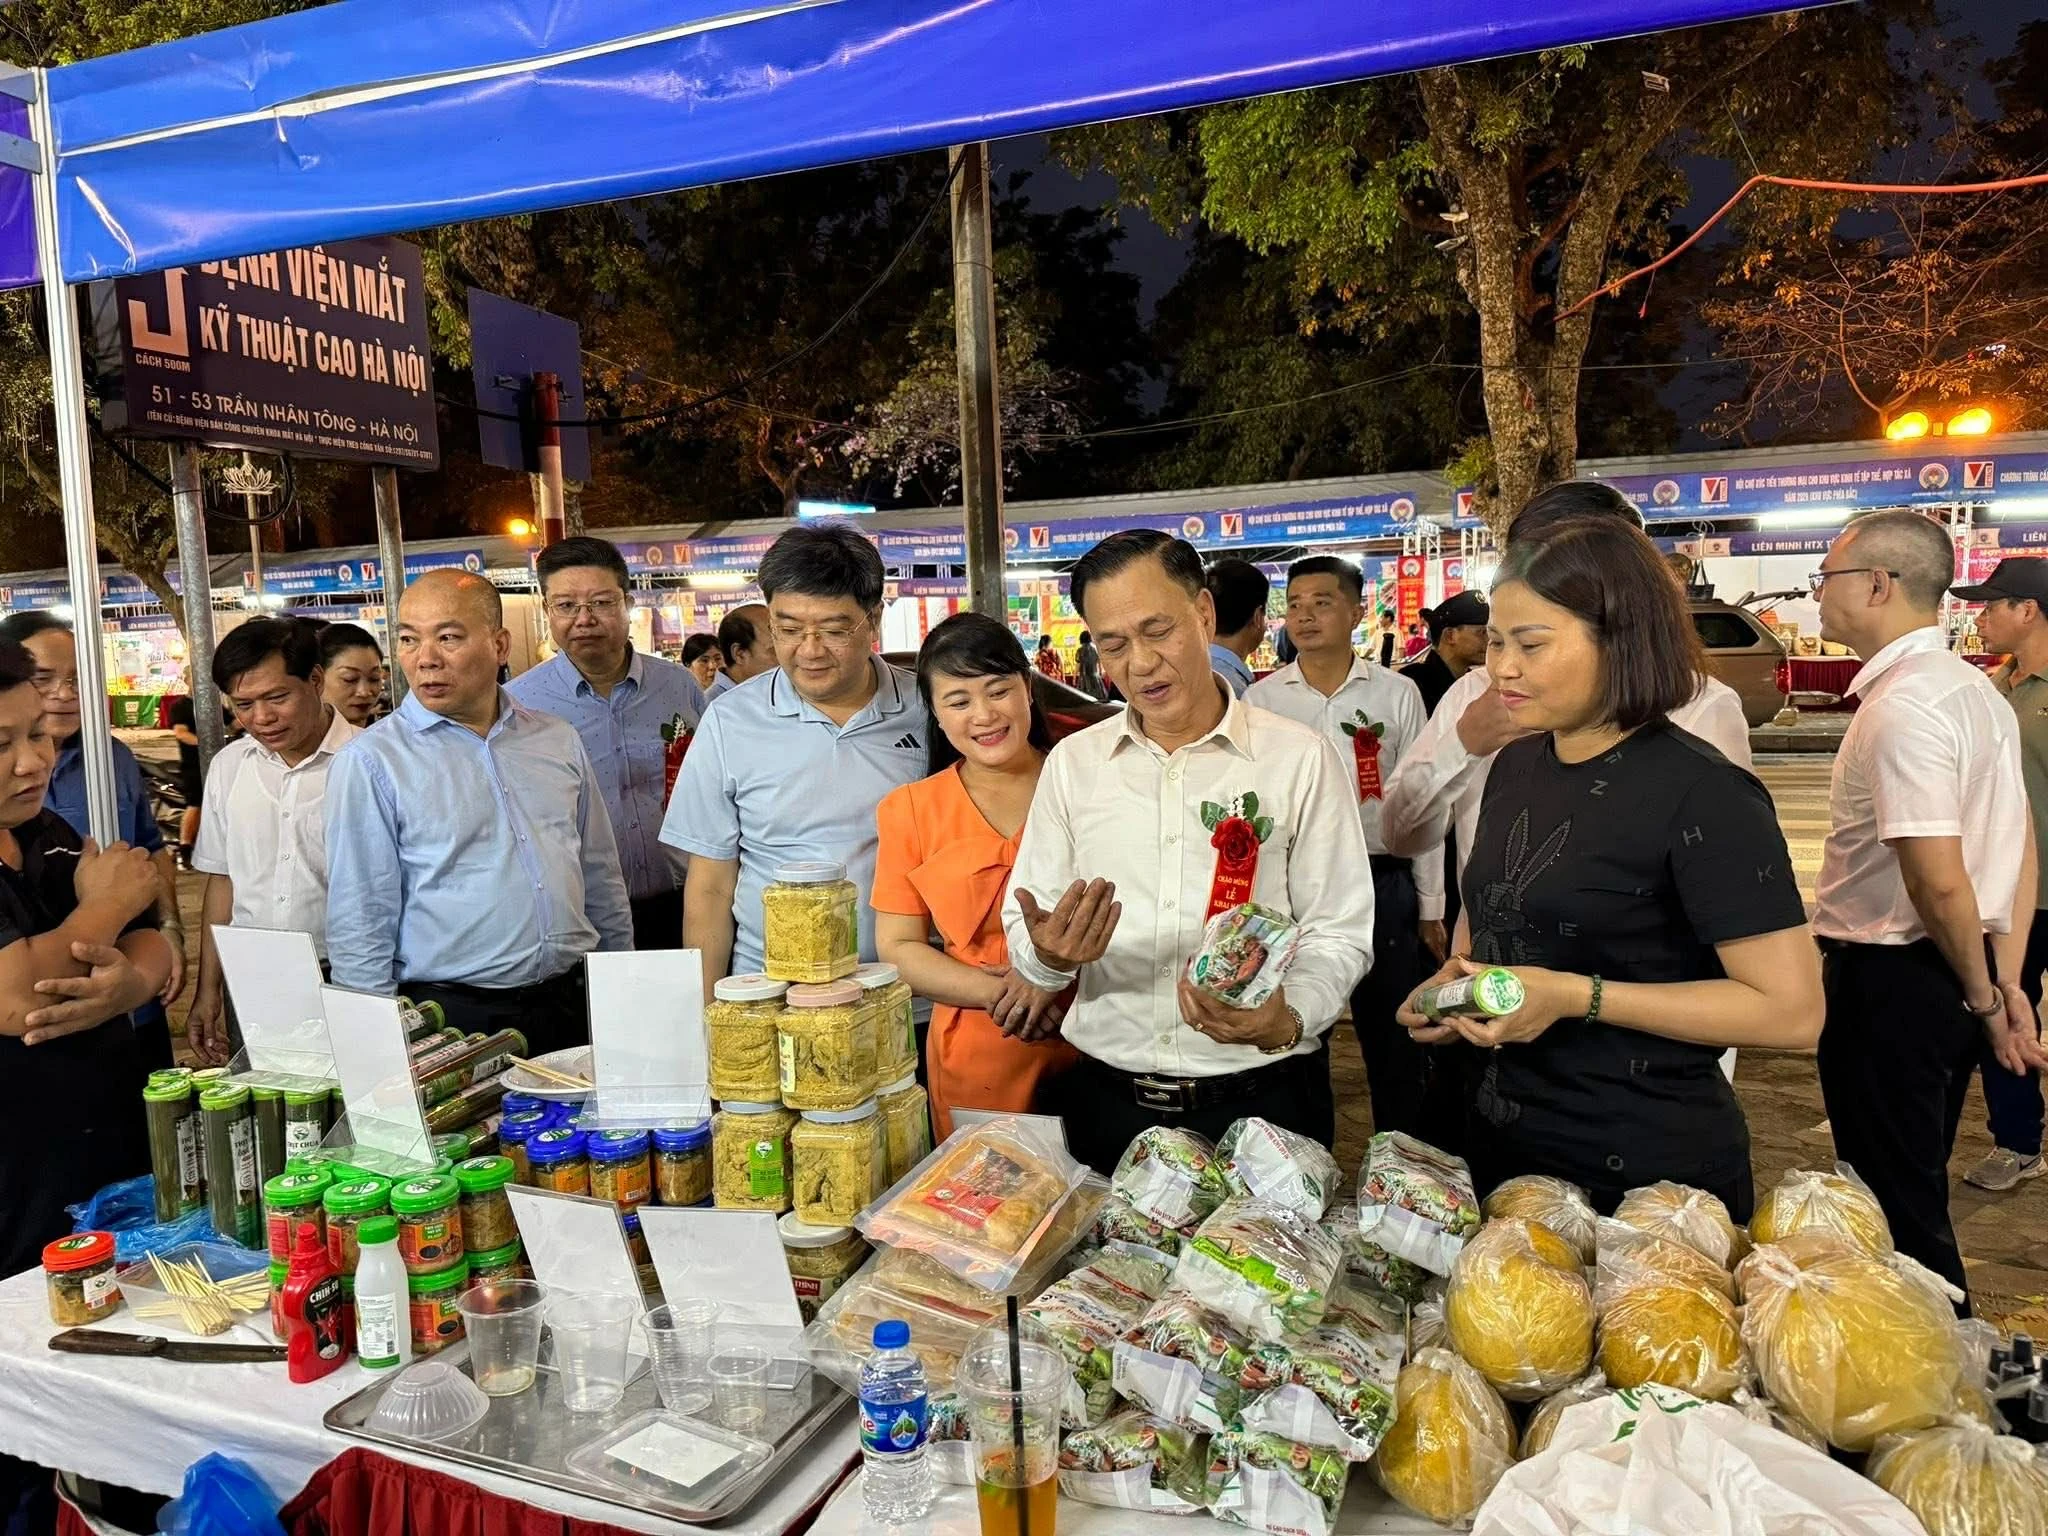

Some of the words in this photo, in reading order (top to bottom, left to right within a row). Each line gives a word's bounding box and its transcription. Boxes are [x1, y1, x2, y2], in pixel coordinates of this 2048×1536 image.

[286, 246, 350, 313] VIỆN
[353, 255, 407, 324] MẮT
[135, 352, 163, 369] CÁCH
[164, 358, 191, 373] 500M
[200, 302, 231, 353] KỸ
[236, 314, 309, 374] THUẬT
[314, 331, 356, 378] CAO
[362, 338, 388, 385] HÀ
[394, 344, 427, 397] NỘI
[152, 385, 171, 404] 51
[191, 391, 212, 410] 53
[215, 392, 258, 418] TRẦN
[263, 402, 309, 426] NHÂN
[312, 408, 356, 433] TÔNG
[370, 417, 390, 439] HÀ
[394, 423, 418, 446] NỘI
[1752, 540, 1773, 552] LIÊN
[1776, 540, 1801, 551] MINH
[1804, 539, 1824, 550] HTX
[2023, 530, 2047, 542] LIÊN
